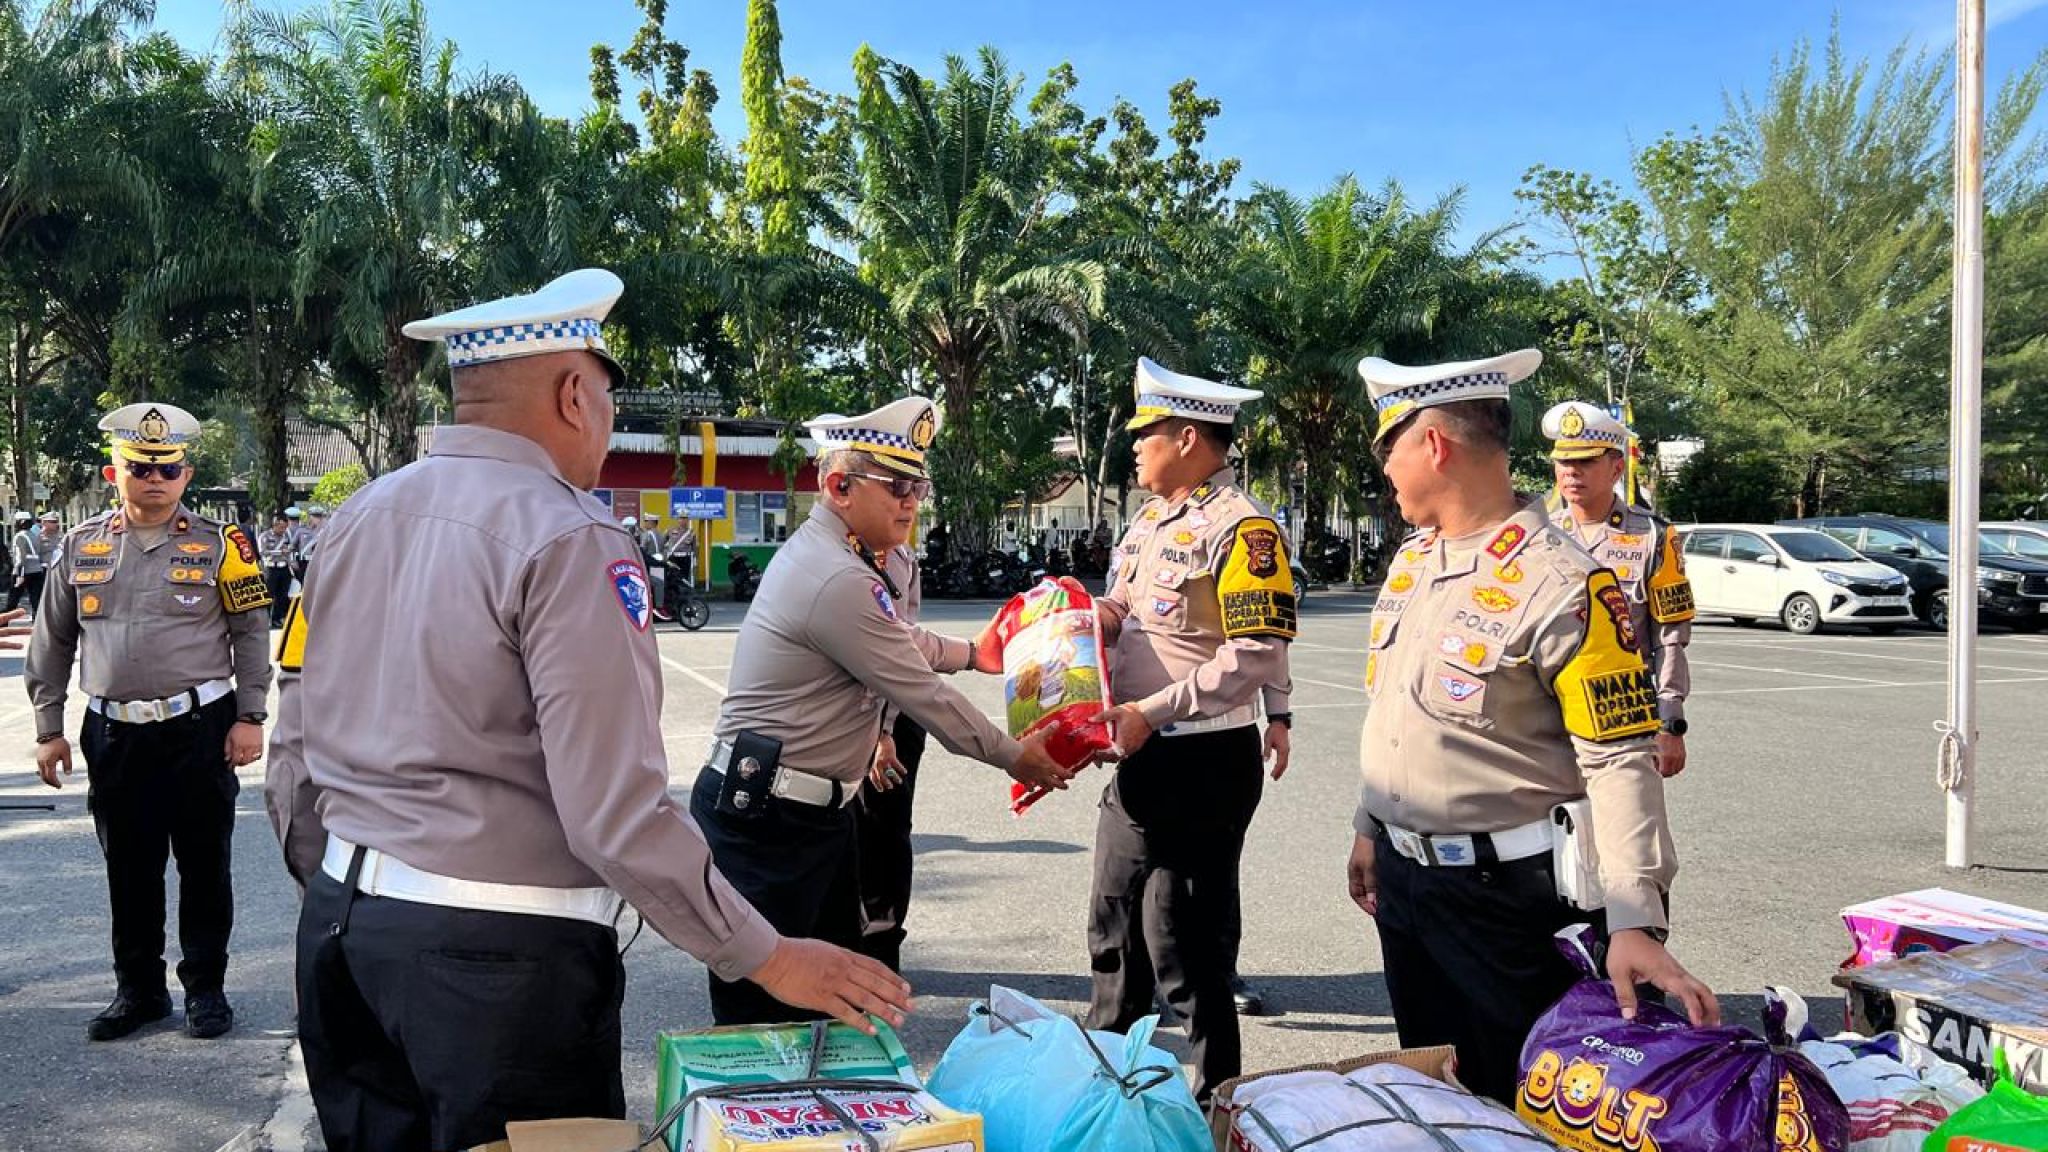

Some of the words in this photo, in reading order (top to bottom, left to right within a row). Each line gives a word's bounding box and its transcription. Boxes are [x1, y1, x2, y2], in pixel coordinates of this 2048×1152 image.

[693, 490, 702, 502] P
[170, 556, 212, 566] POLRI
[1160, 549, 1189, 564] POLRI
[1607, 549, 1642, 560] POLRI
[1453, 610, 1510, 639] POLRI
[1525, 1050, 1667, 1150] BOLT
